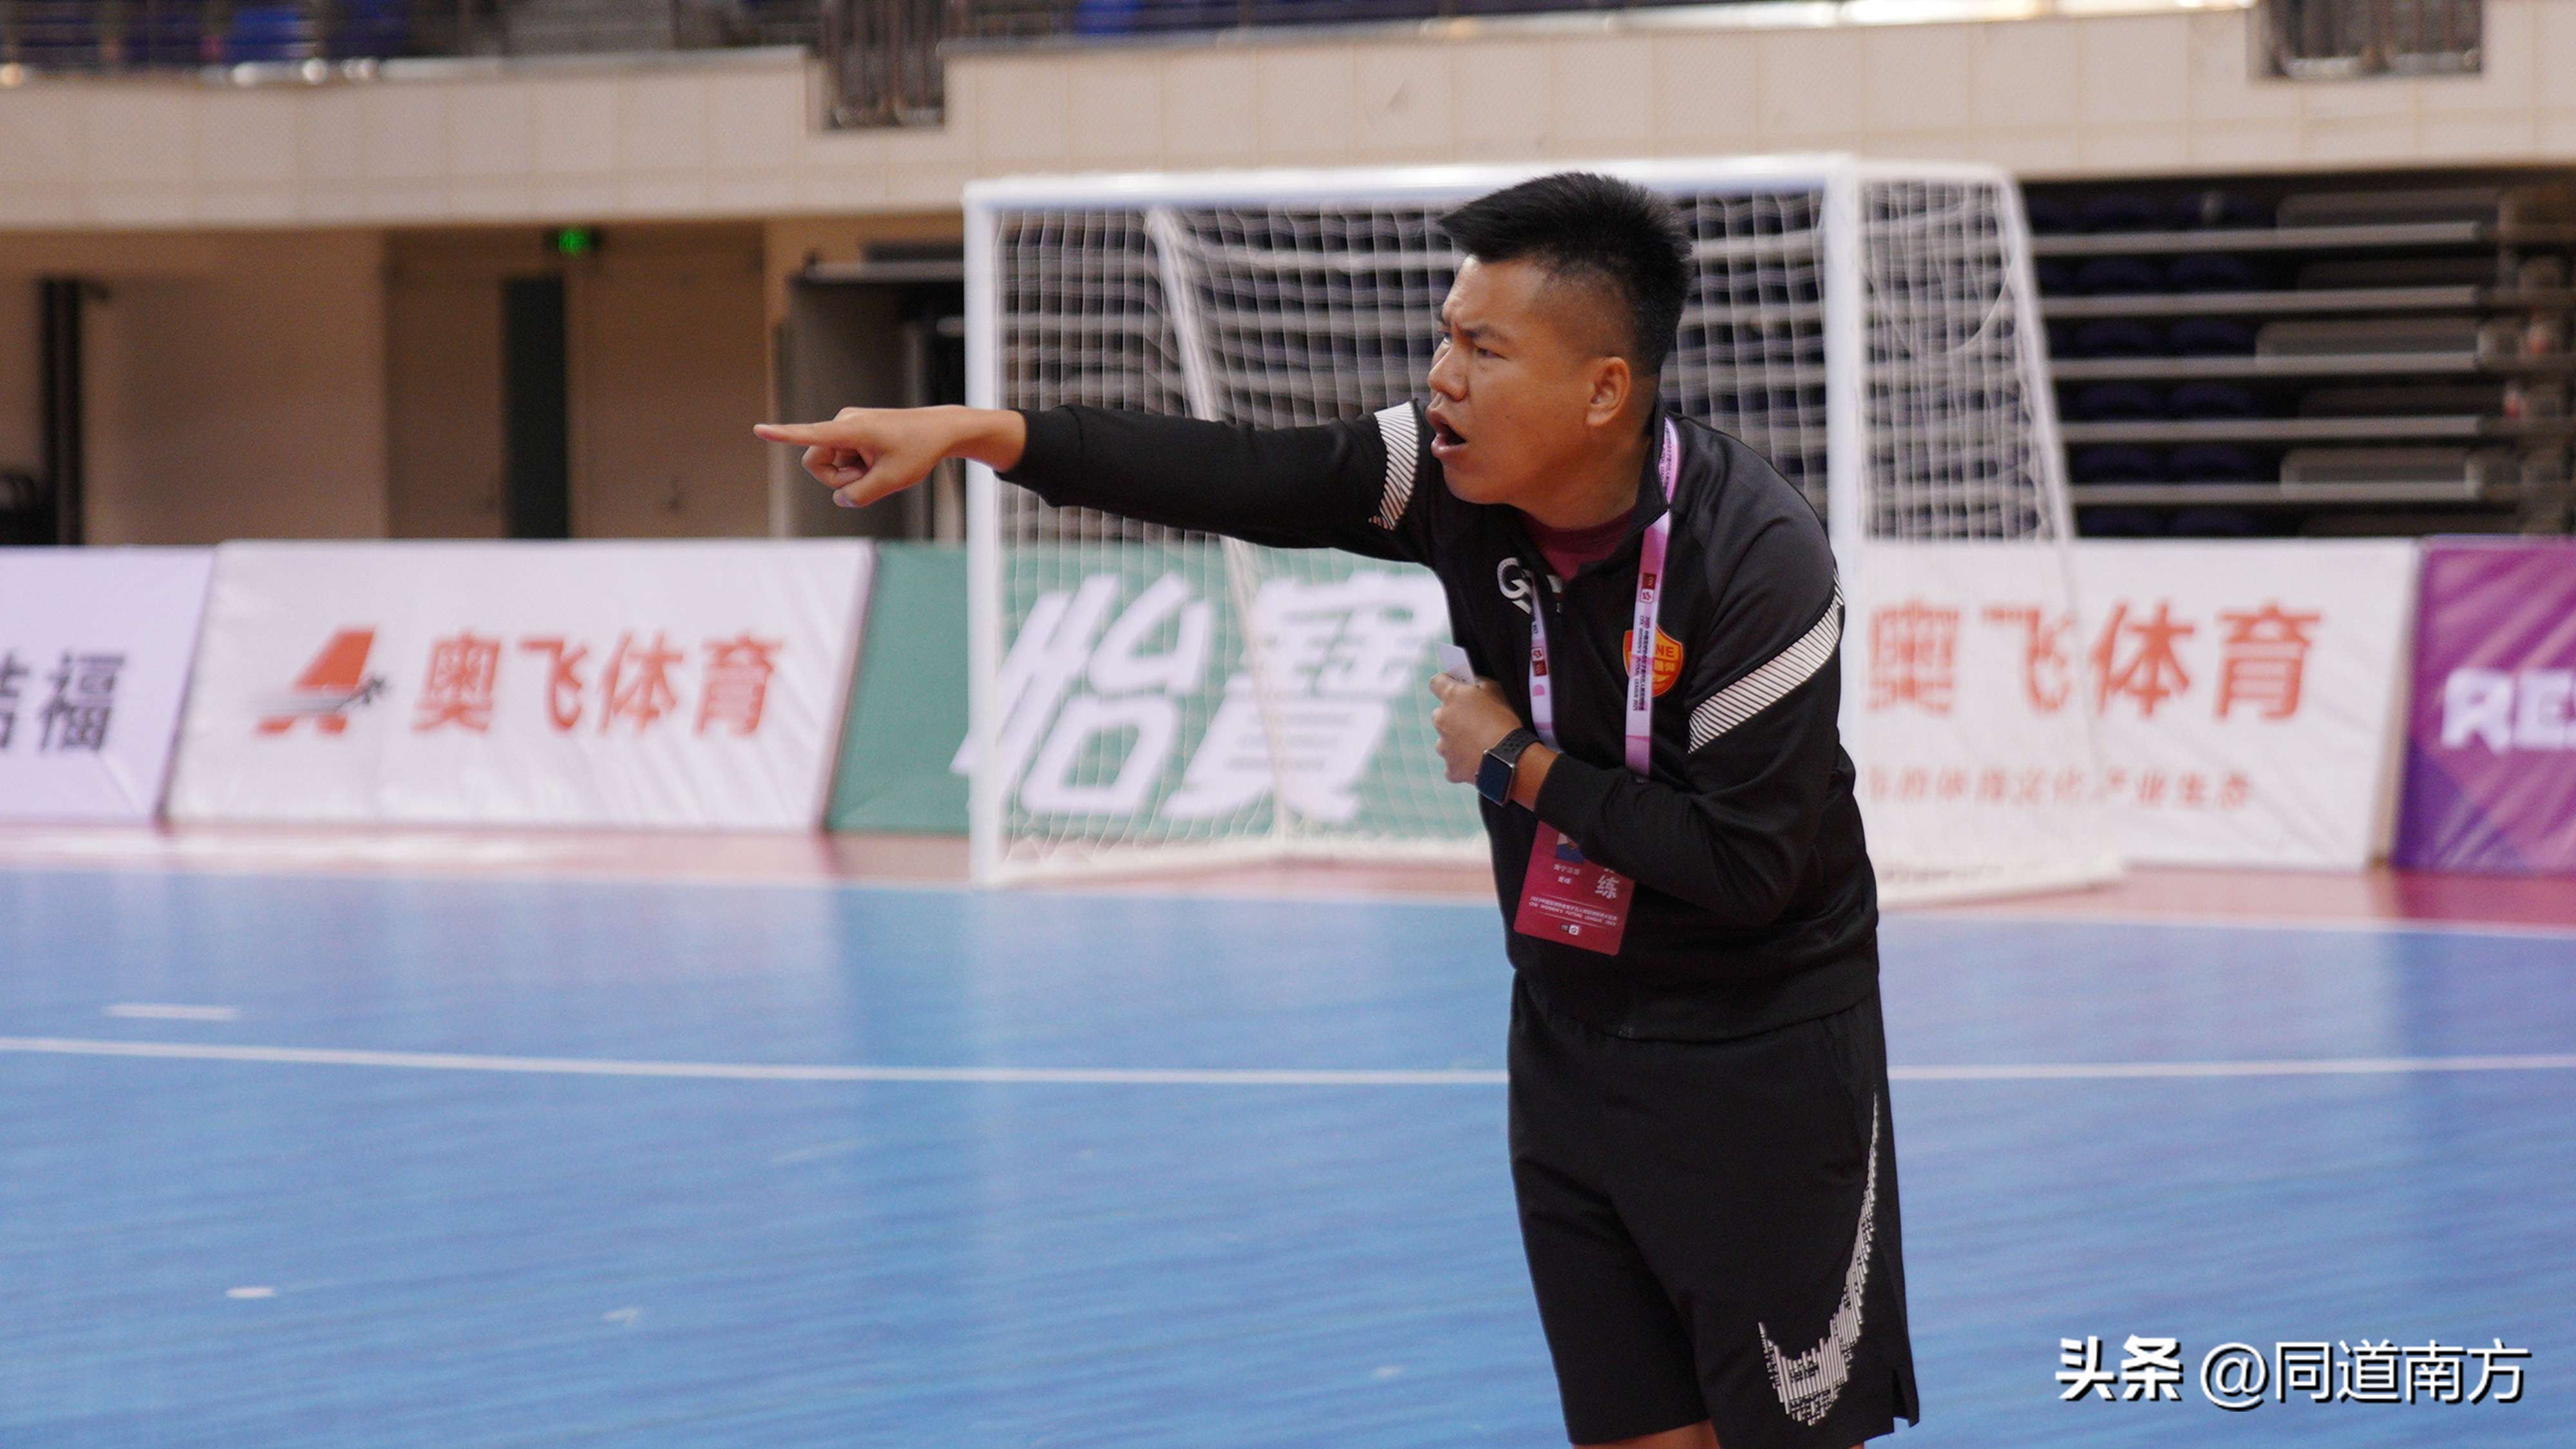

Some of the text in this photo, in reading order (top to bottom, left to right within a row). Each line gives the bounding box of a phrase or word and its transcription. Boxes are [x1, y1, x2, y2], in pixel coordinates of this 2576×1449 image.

[413, 630, 782, 735] 奥飞体育
[1865, 598, 2321, 721] 奥飞体育
[2441, 668, 2576, 755] RE
